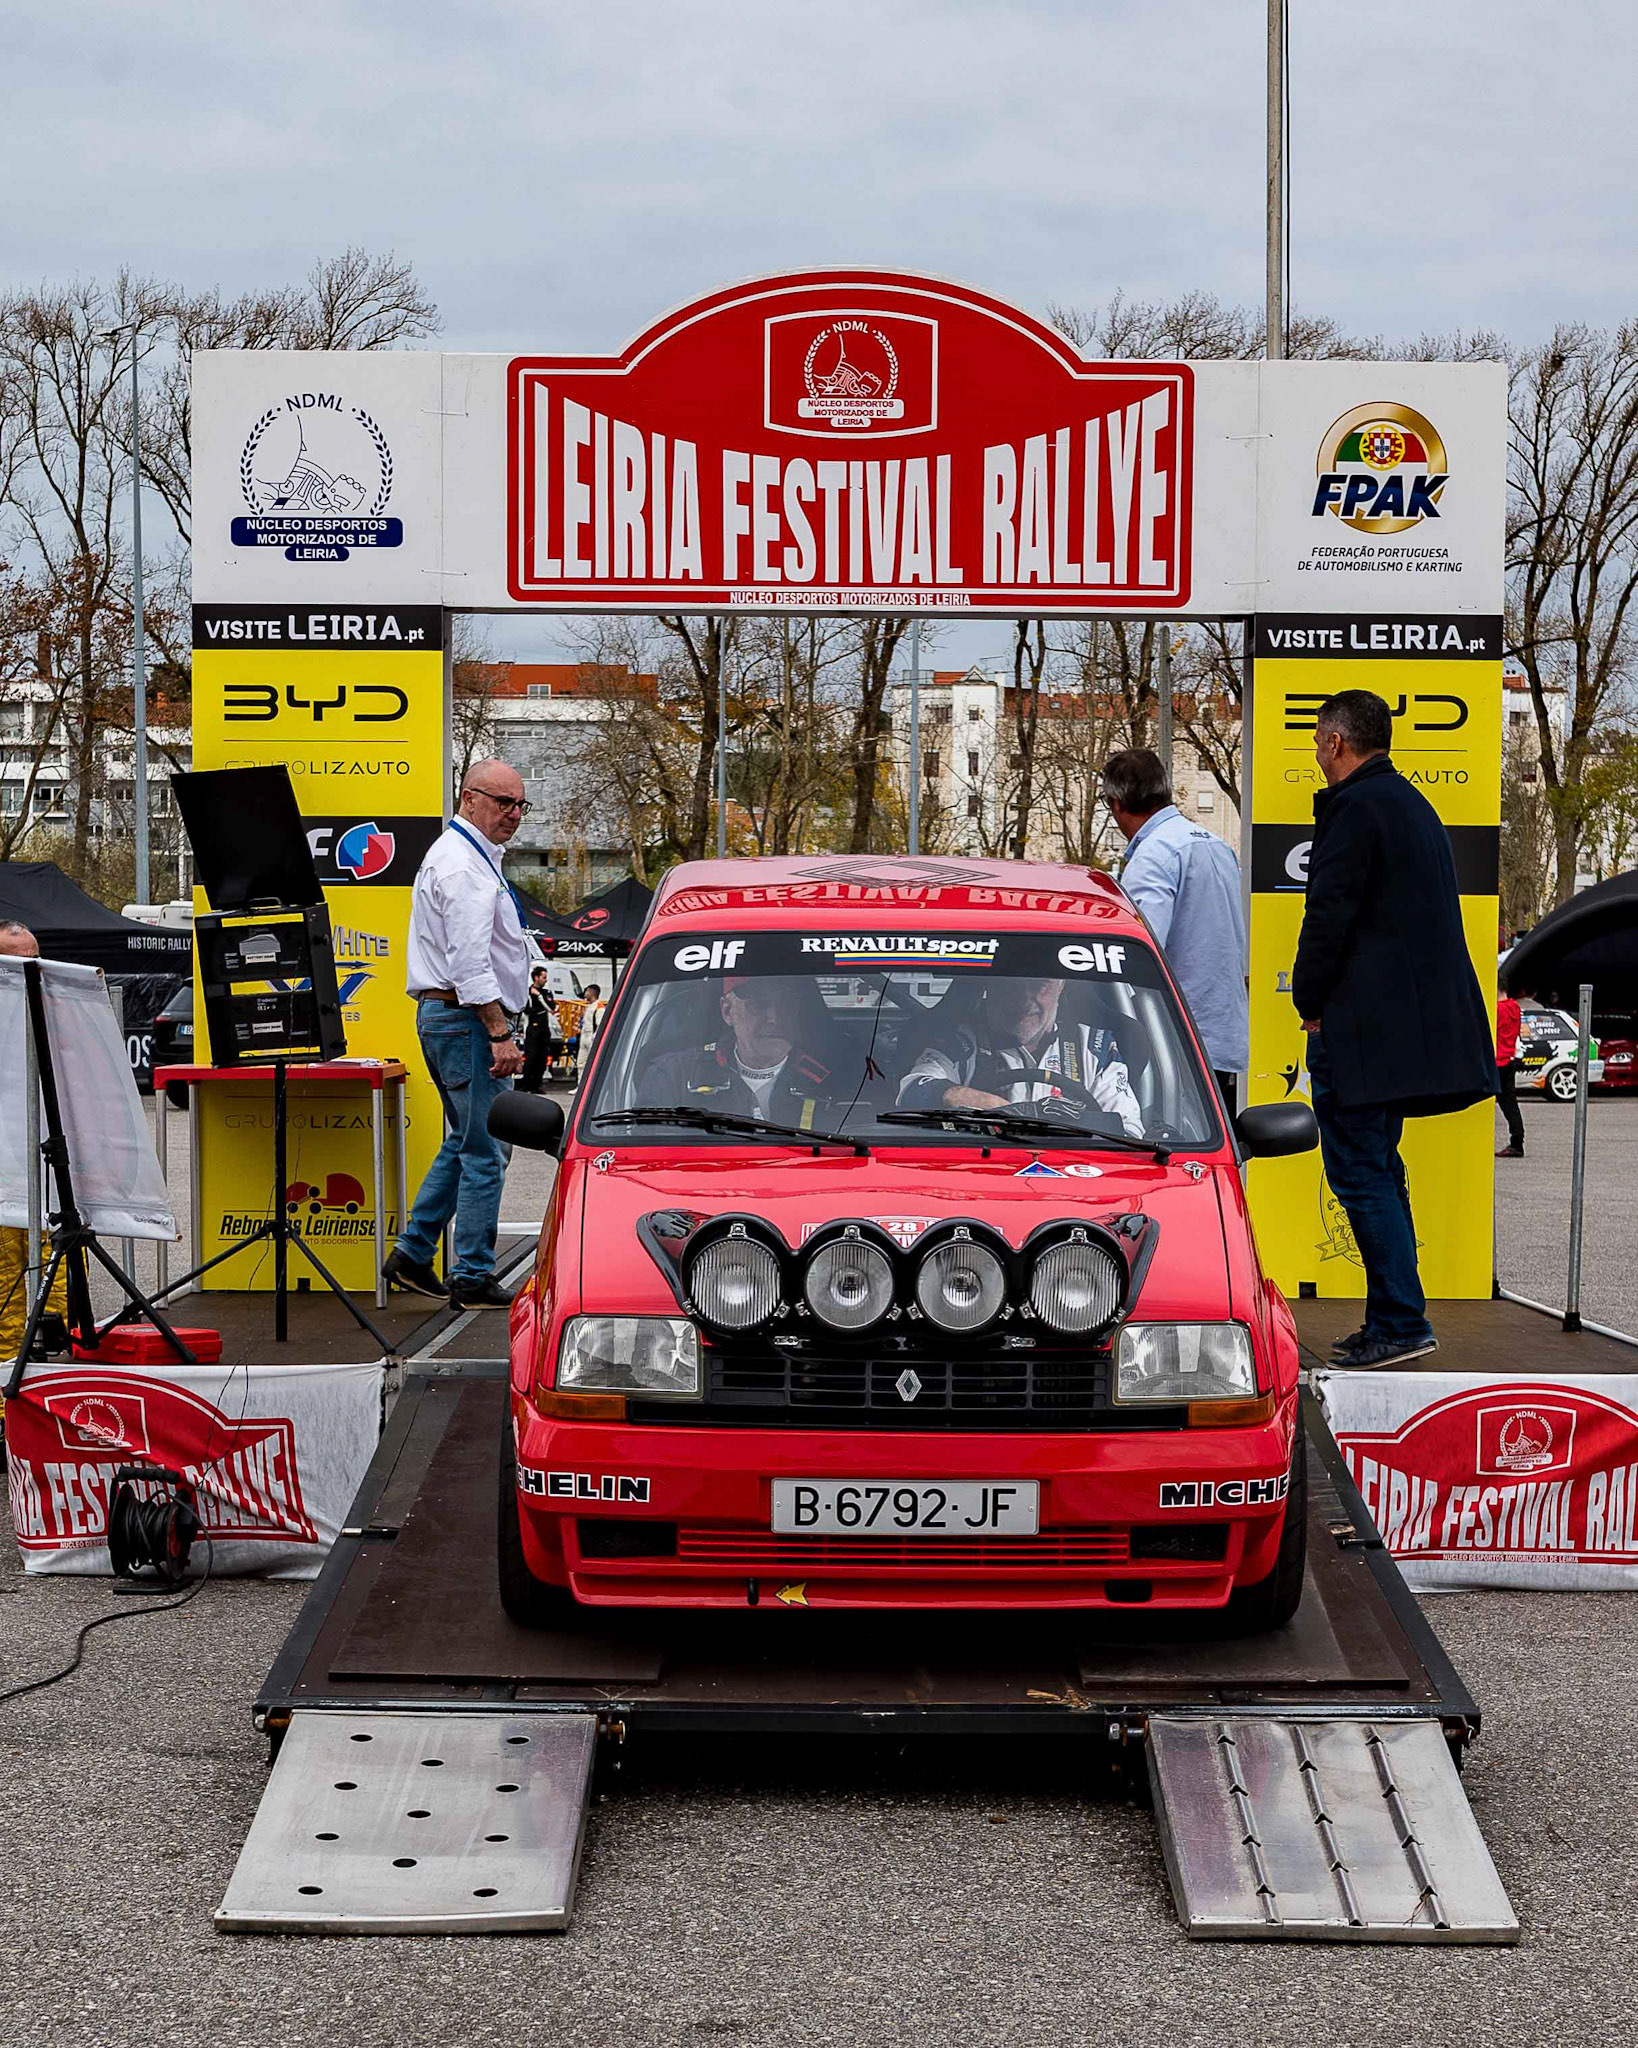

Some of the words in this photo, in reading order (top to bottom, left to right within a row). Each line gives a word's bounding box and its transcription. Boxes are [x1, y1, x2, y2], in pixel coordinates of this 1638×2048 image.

[832, 320, 869, 334] NDML
[286, 392, 344, 413] NDML
[843, 400, 895, 408] DESPORTOS
[814, 409, 875, 417] MOTORIZADOS
[533, 381, 703, 580] LEIRIA
[722, 448, 964, 584] FESTIVAL
[982, 386, 1170, 586] RALLYE
[1311, 473, 1450, 518] FPAK
[305, 519, 388, 532] DESPORTOS
[256, 533, 356, 545] MOTORIZADOS
[358, 533, 377, 545] DE
[295, 547, 339, 560] LEIRIA
[1311, 545, 1376, 560] FEDERAÇÃO
[1377, 547, 1449, 559] PORTUGUESA
[1297, 560, 1312, 572] DE
[1313, 560, 1403, 572] AUTOMOBILISMO
[1406, 561, 1414, 572] E
[1415, 561, 1463, 573] KARTING
[775, 592, 839, 605] DESPORTOS
[841, 592, 917, 606] MOTORIZADOS
[919, 593, 934, 606] DE
[935, 594, 971, 606] LEIRIA
[204, 620, 282, 640] VISITE
[1267, 629, 1344, 649] VISITE
[223, 684, 409, 722] BYD
[127, 936, 167, 950] HISTORIC
[167, 937, 192, 951] RALLY
[557, 940, 605, 954] 24MX
[673, 940, 746, 972] elf
[1057, 942, 1126, 975] elf
[887, 1221, 918, 1233] 28
[1440, 1479, 1576, 1550] FESTIVAL
